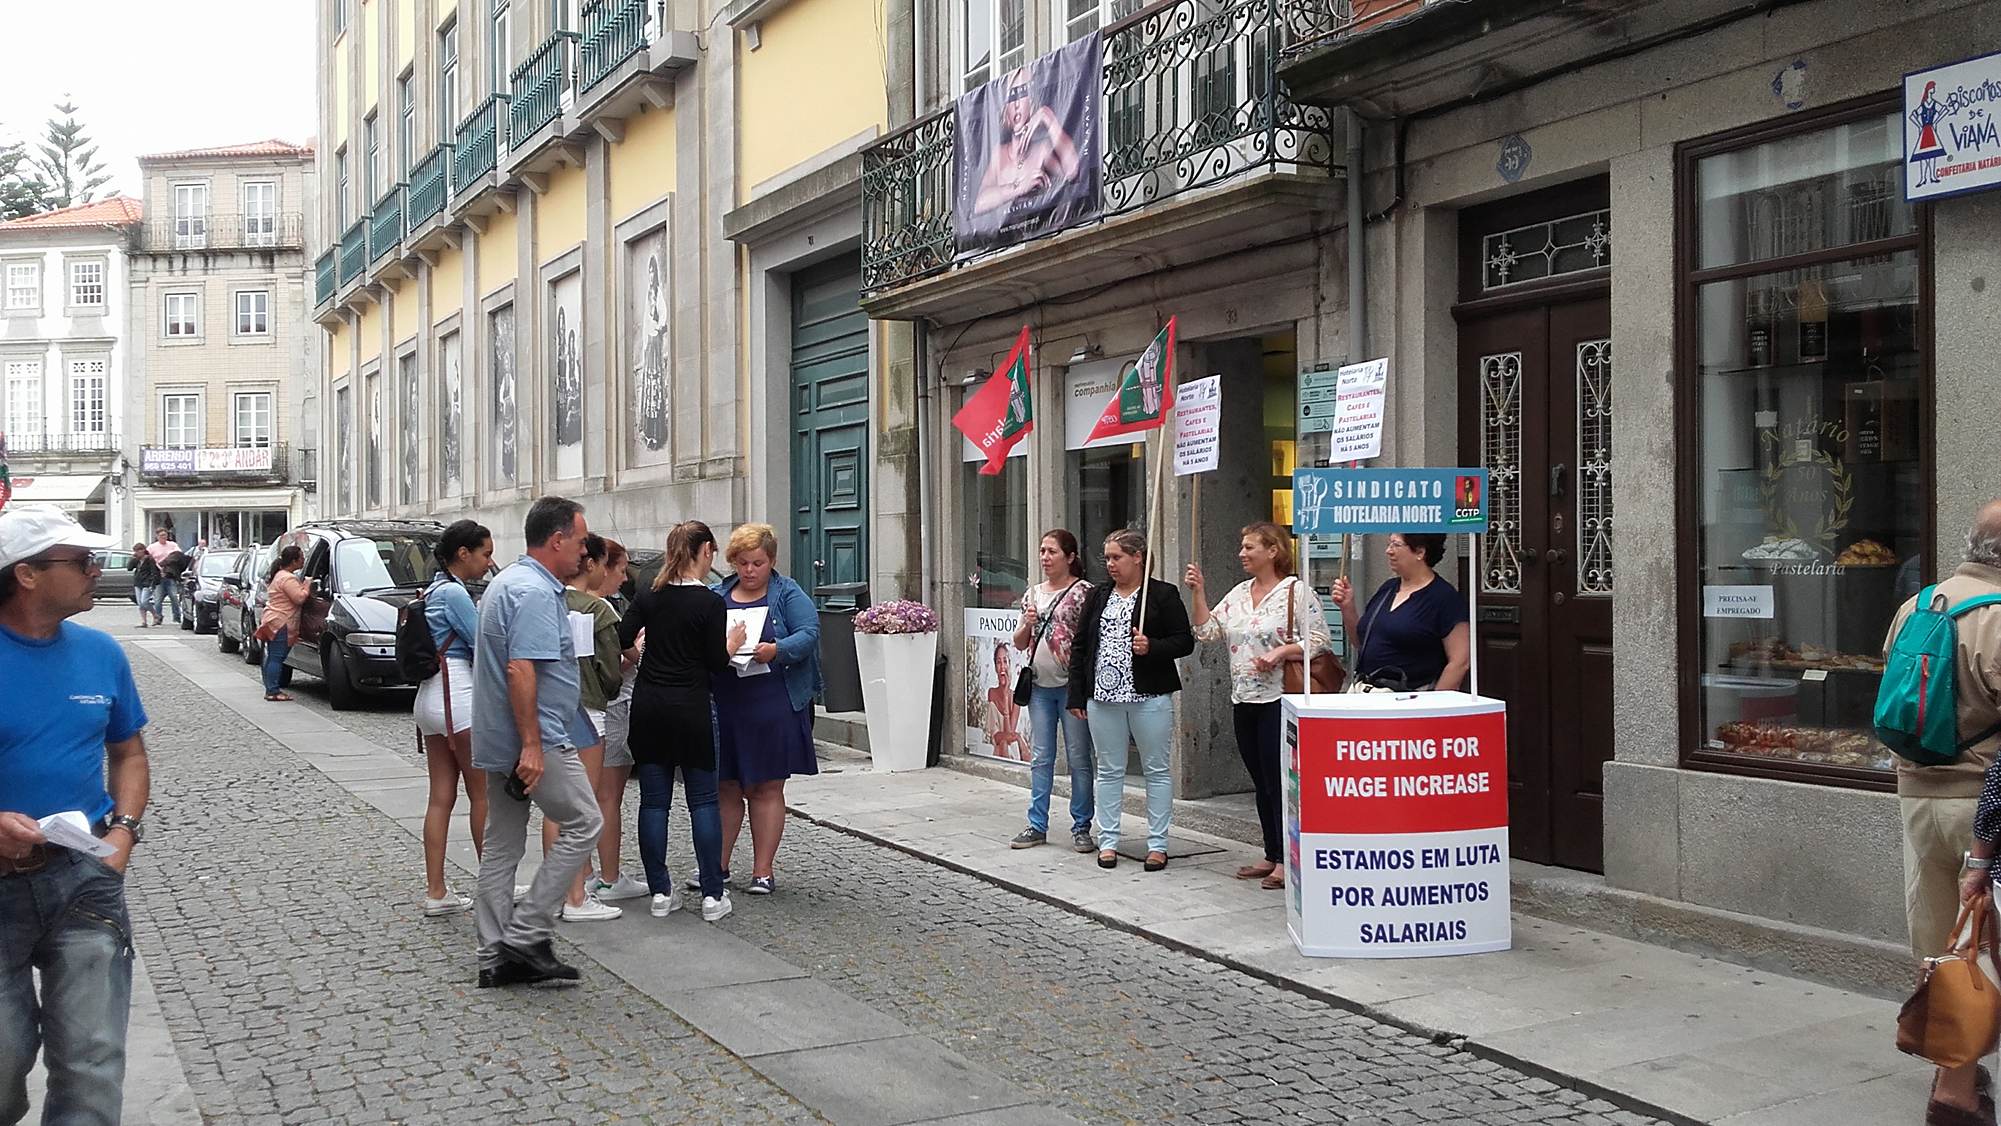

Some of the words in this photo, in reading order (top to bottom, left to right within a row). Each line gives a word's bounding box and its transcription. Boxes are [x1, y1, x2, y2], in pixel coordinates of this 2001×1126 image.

[1968, 108, 1984, 120] DE
[1936, 161, 1976, 178] CONFEITARIA
[1074, 381, 1116, 397] companhia
[1338, 412, 1376, 424] PASTELARIAS
[1346, 422, 1380, 432] AUMENTAM
[1761, 414, 1850, 451] Natário
[1187, 436, 1217, 447] AUMENTAM
[1353, 442, 1369, 450] ANOS
[144, 451, 192, 462] ARRENDO
[235, 450, 269, 467] ANDAR
[177, 462, 191, 470] 401
[1334, 480, 1442, 498] SINDICATO
[1334, 505, 1399, 523] HOTELARIA
[1402, 505, 1441, 523] NORTE
[1455, 508, 1480, 518] CGTP
[1770, 560, 1847, 576] Pastelaria
[1716, 607, 1761, 615] EMPREGADO
[979, 616, 1018, 632] PANDOR
[1336, 738, 1437, 761] FIGHTING
[1442, 737, 1479, 758] FOR
[1324, 777, 1387, 797] WAGE
[1394, 772, 1489, 796] INCREASE
[1315, 849, 1415, 870] ESTAMOS
[1422, 848, 1449, 868] EM
[1456, 844, 1501, 866] LUTA
[1331, 887, 1375, 906] POR
[1381, 881, 1489, 906] AUMENTOS
[1360, 920, 1467, 943] SALARIAIS
